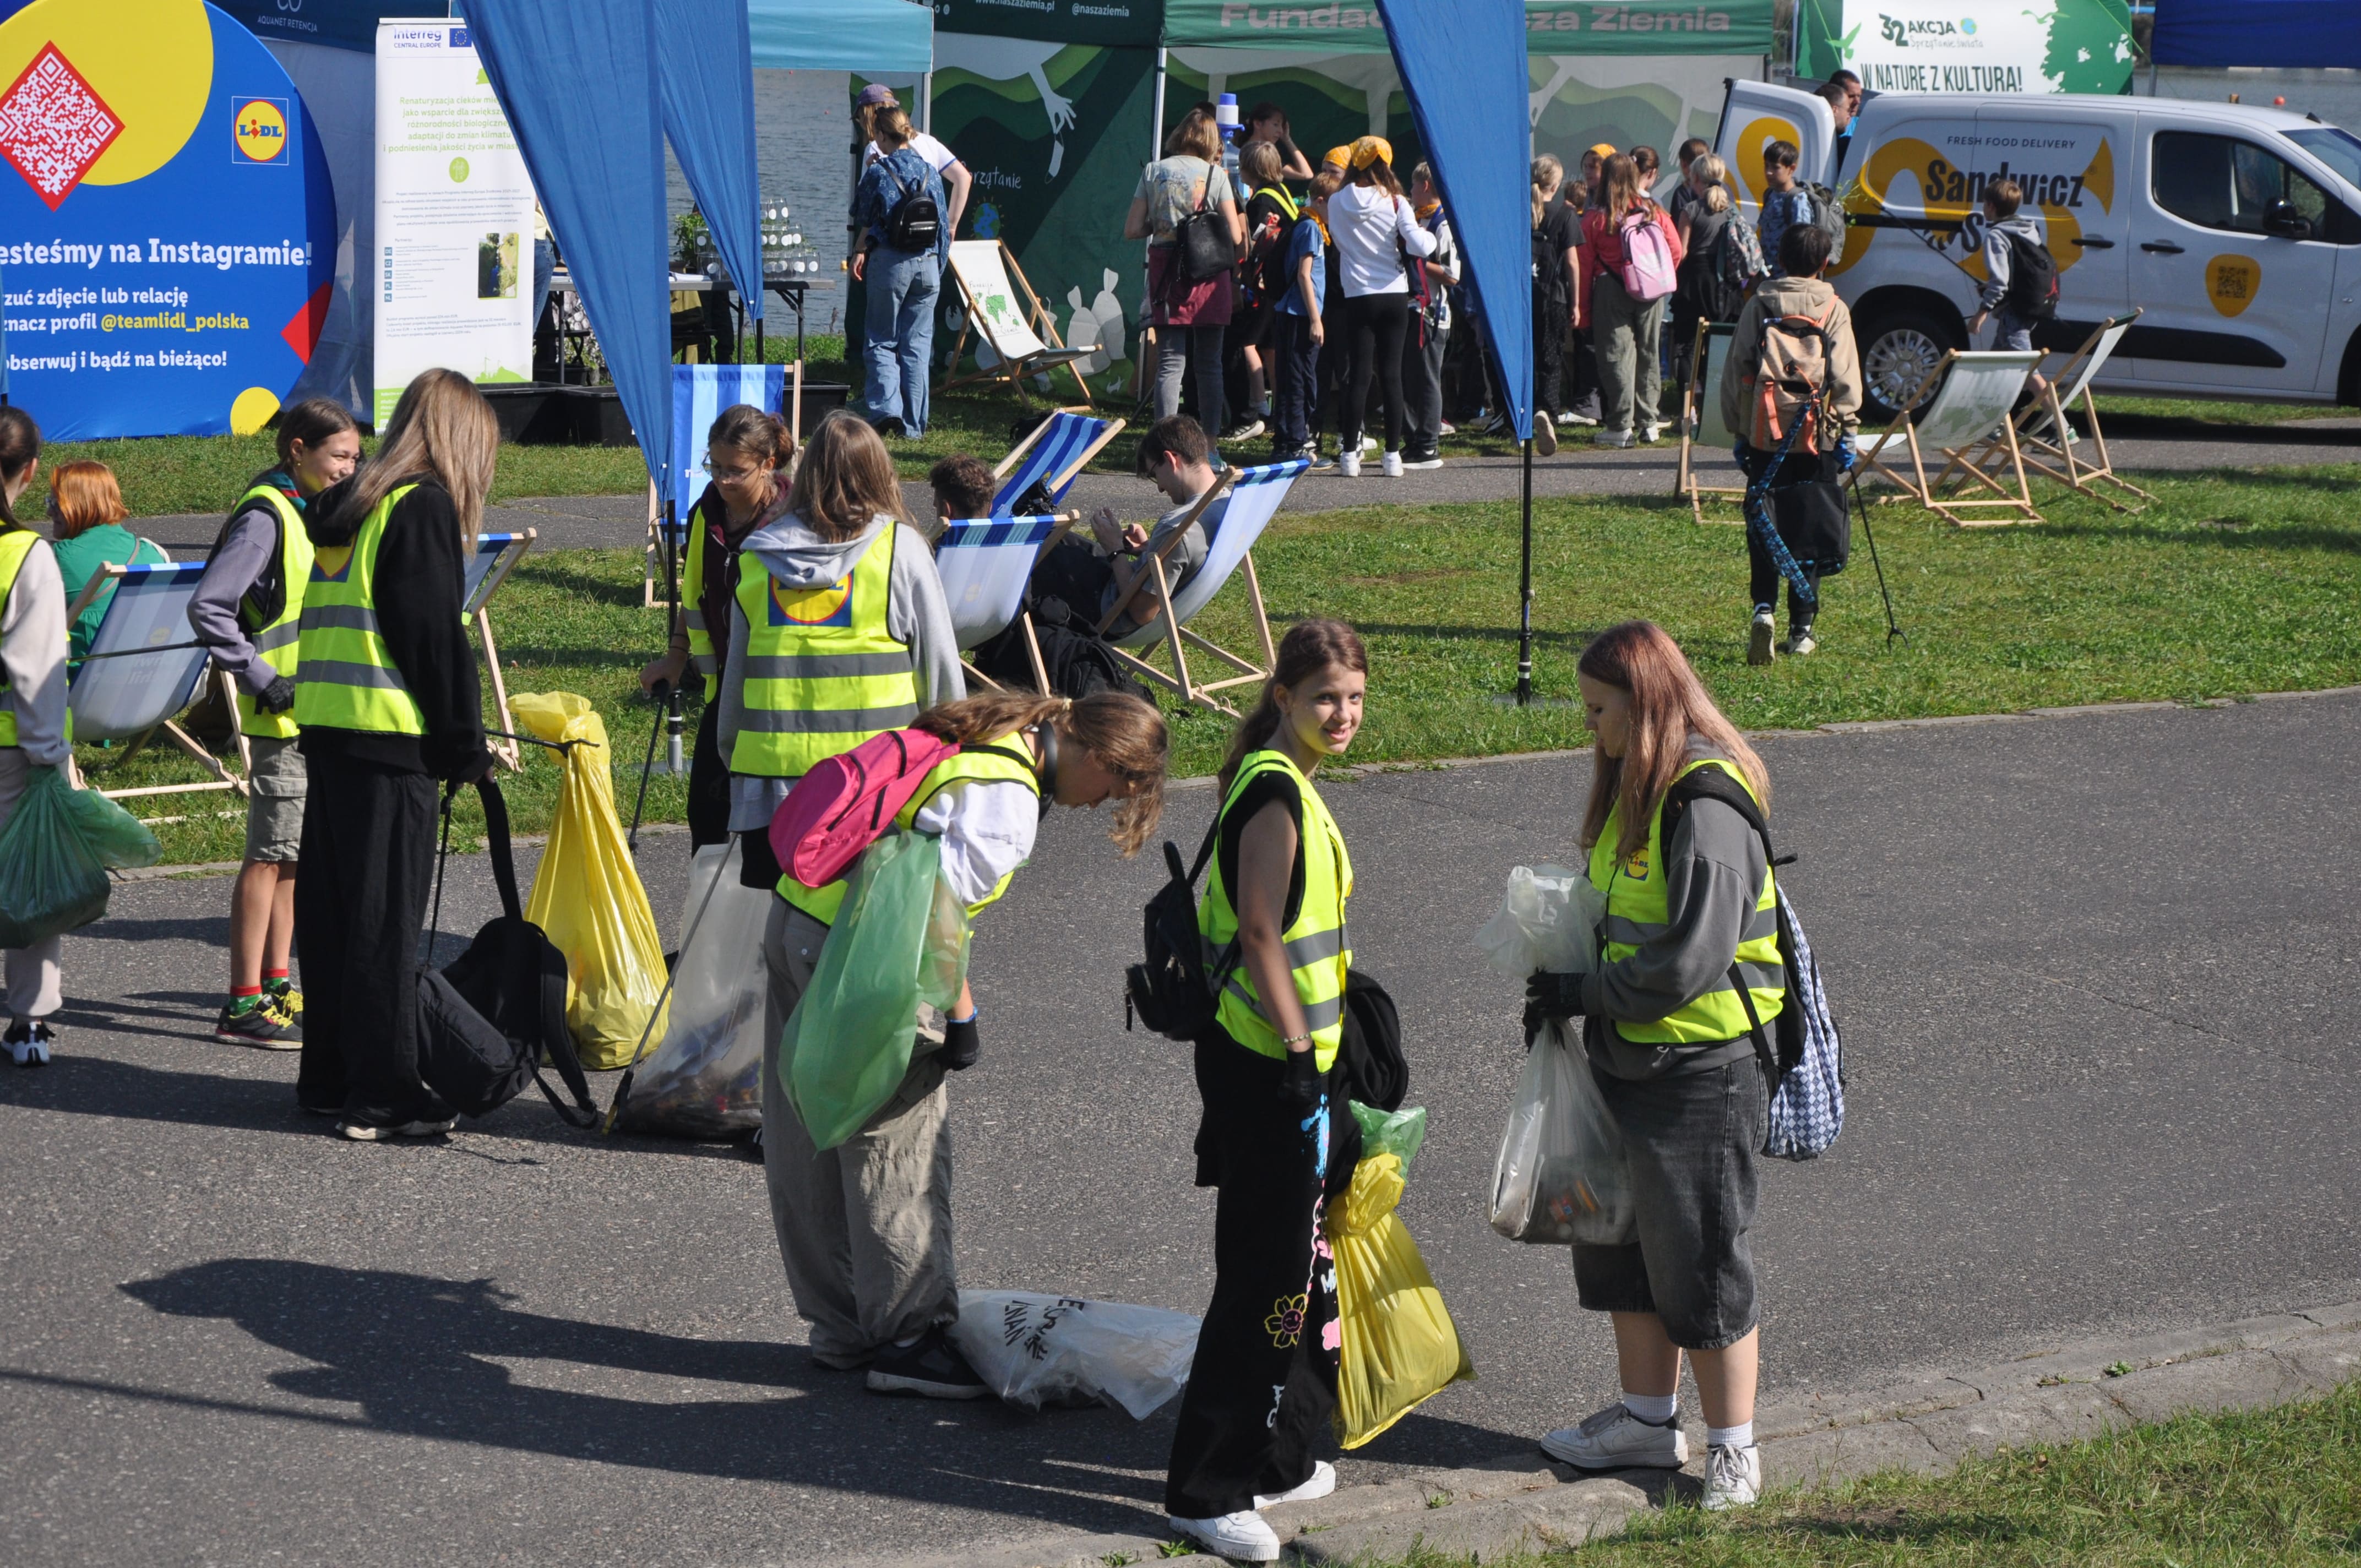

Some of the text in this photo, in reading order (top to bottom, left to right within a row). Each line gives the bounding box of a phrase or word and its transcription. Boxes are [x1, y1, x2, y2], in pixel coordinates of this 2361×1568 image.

[1072, 3, 1129, 17] @naszaziemia
[257, 15, 318, 32] AQUANET RETENCJA
[1525, 11, 1581, 30] za
[1591, 7, 1731, 31] Ziemia
[394, 28, 442, 41] Interreg
[1908, 21, 1957, 35] AKCJA
[1860, 63, 1872, 89] W
[1875, 64, 1927, 92] NATURĘ
[1930, 66, 1940, 91] Z
[400, 96, 454, 106] Renaturyzacja
[402, 108, 419, 118] jako
[421, 107, 454, 117] wsparcie
[407, 119, 462, 128] różnorodności
[408, 132, 444, 141] adaptacji
[445, 131, 455, 140] do
[1947, 136, 2076, 149] FRESH FOOD DELIVERY
[388, 144, 438, 154] podniesienia
[439, 142, 465, 153] jakości
[467, 143, 486, 152] życia
[961, 161, 1022, 189] rzątanie
[0, 238, 312, 270] esteśmy na Instagramie!
[3, 286, 188, 309] zuć zdjęcie lub relację
[51, 312, 97, 334] profil
[101, 312, 249, 332] @teamlidl_polska
[7, 350, 227, 372] bserwuj i bądź na bieżąco!
